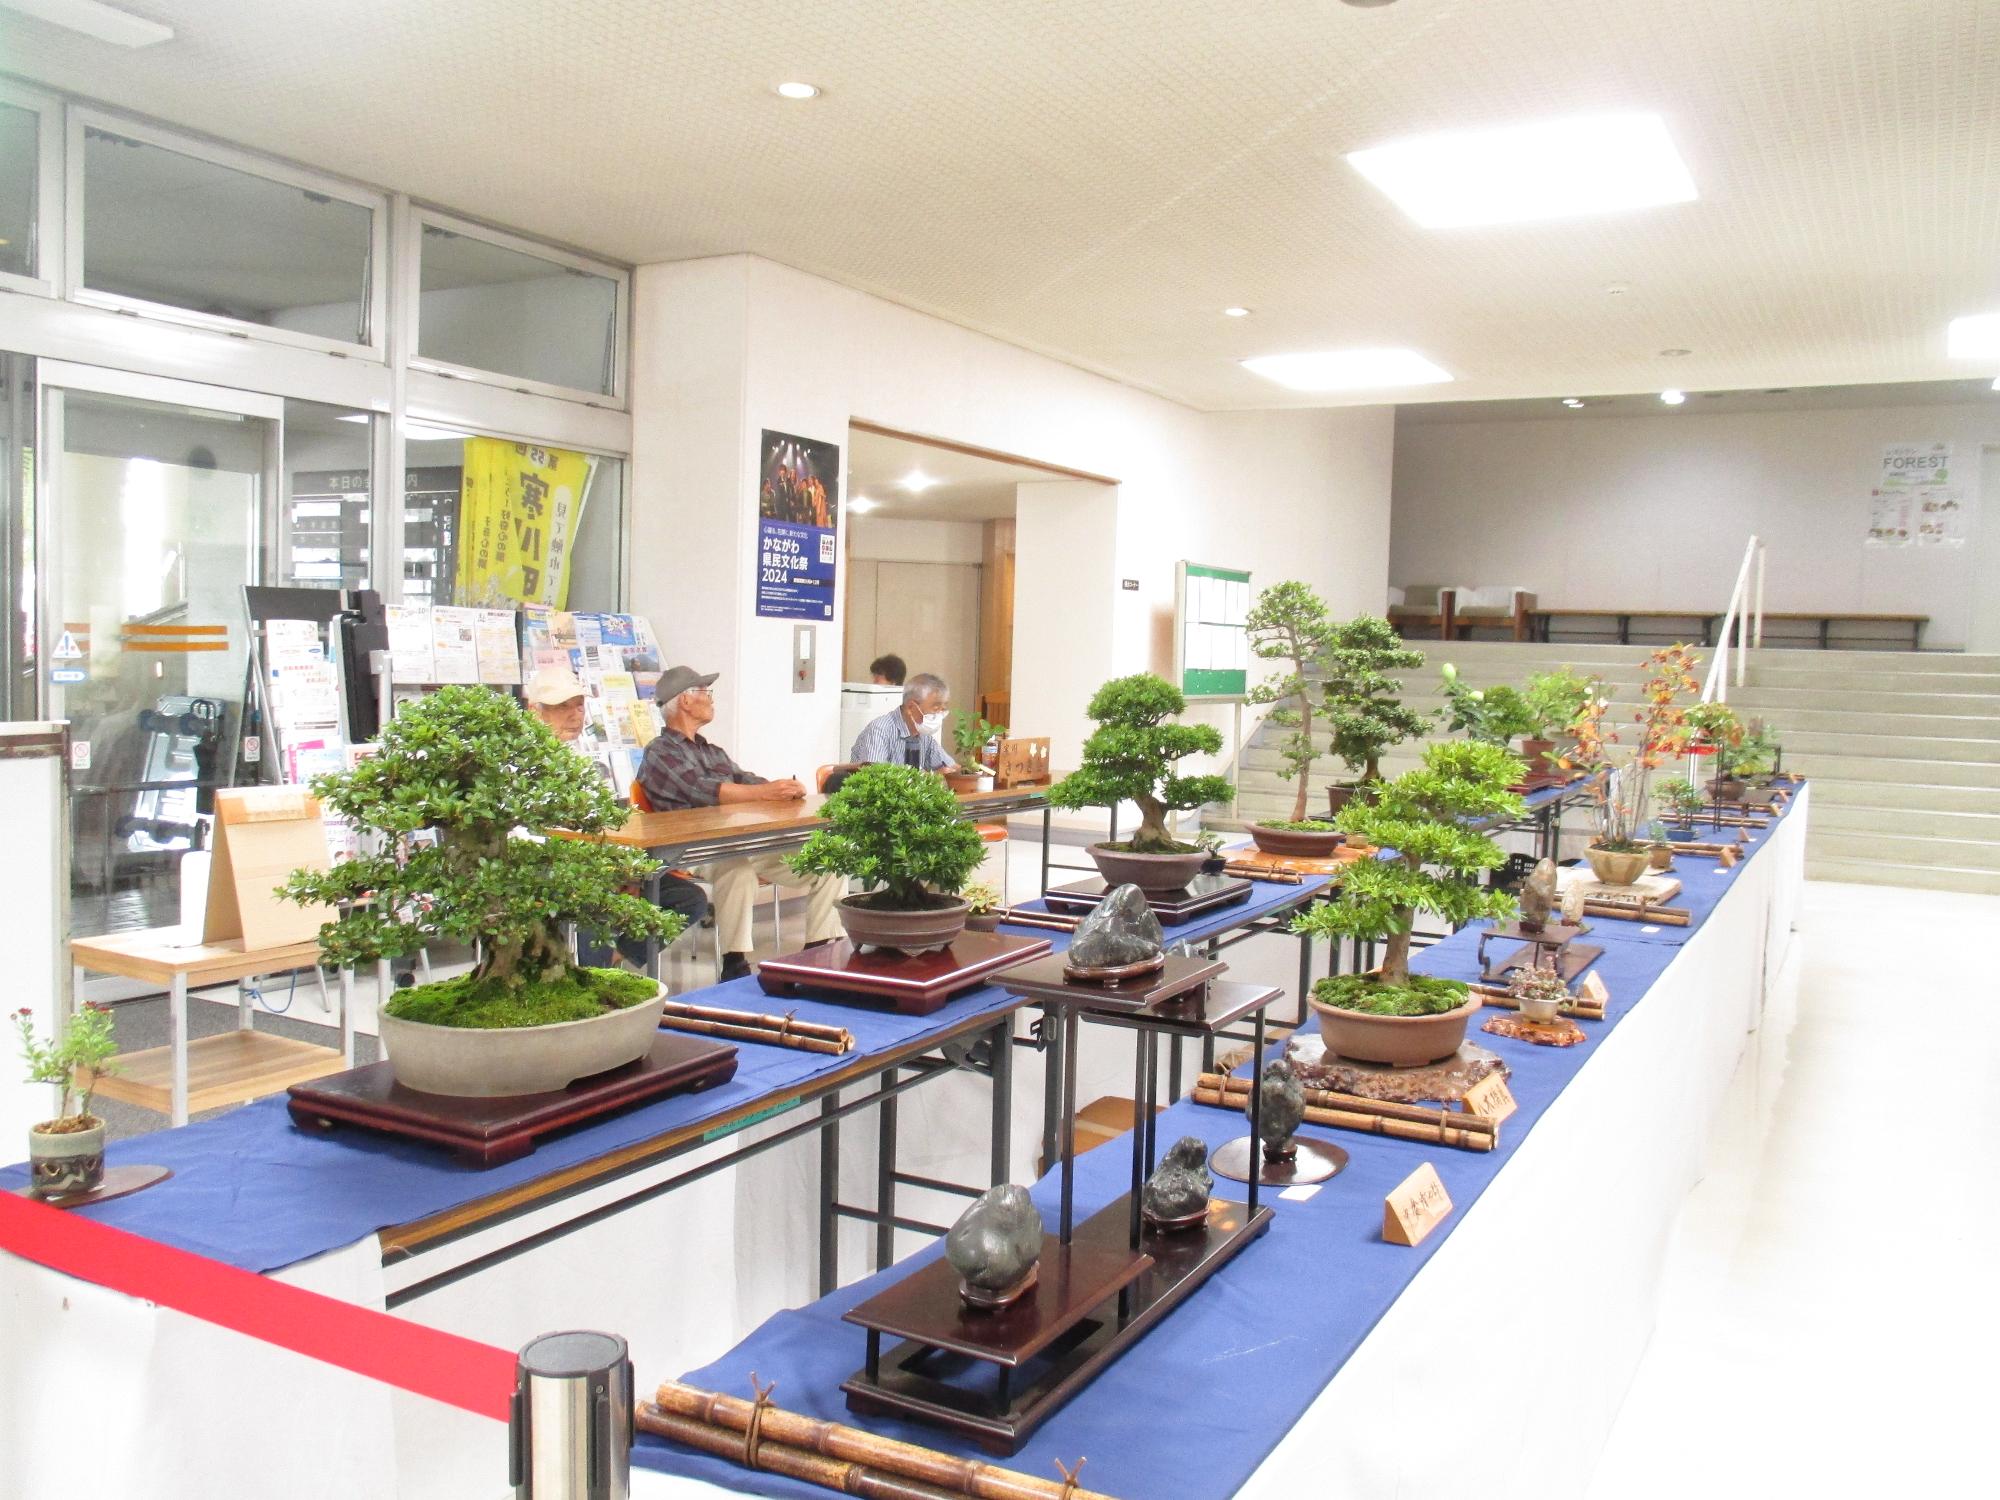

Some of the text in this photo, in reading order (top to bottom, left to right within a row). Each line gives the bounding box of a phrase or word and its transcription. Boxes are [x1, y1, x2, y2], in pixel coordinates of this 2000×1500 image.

[1882, 456, 1949, 470] FOREST
[763, 536, 800, 554] かながわ
[762, 552, 809, 571] 県民文化祭
[761, 568, 788, 584] 2024
